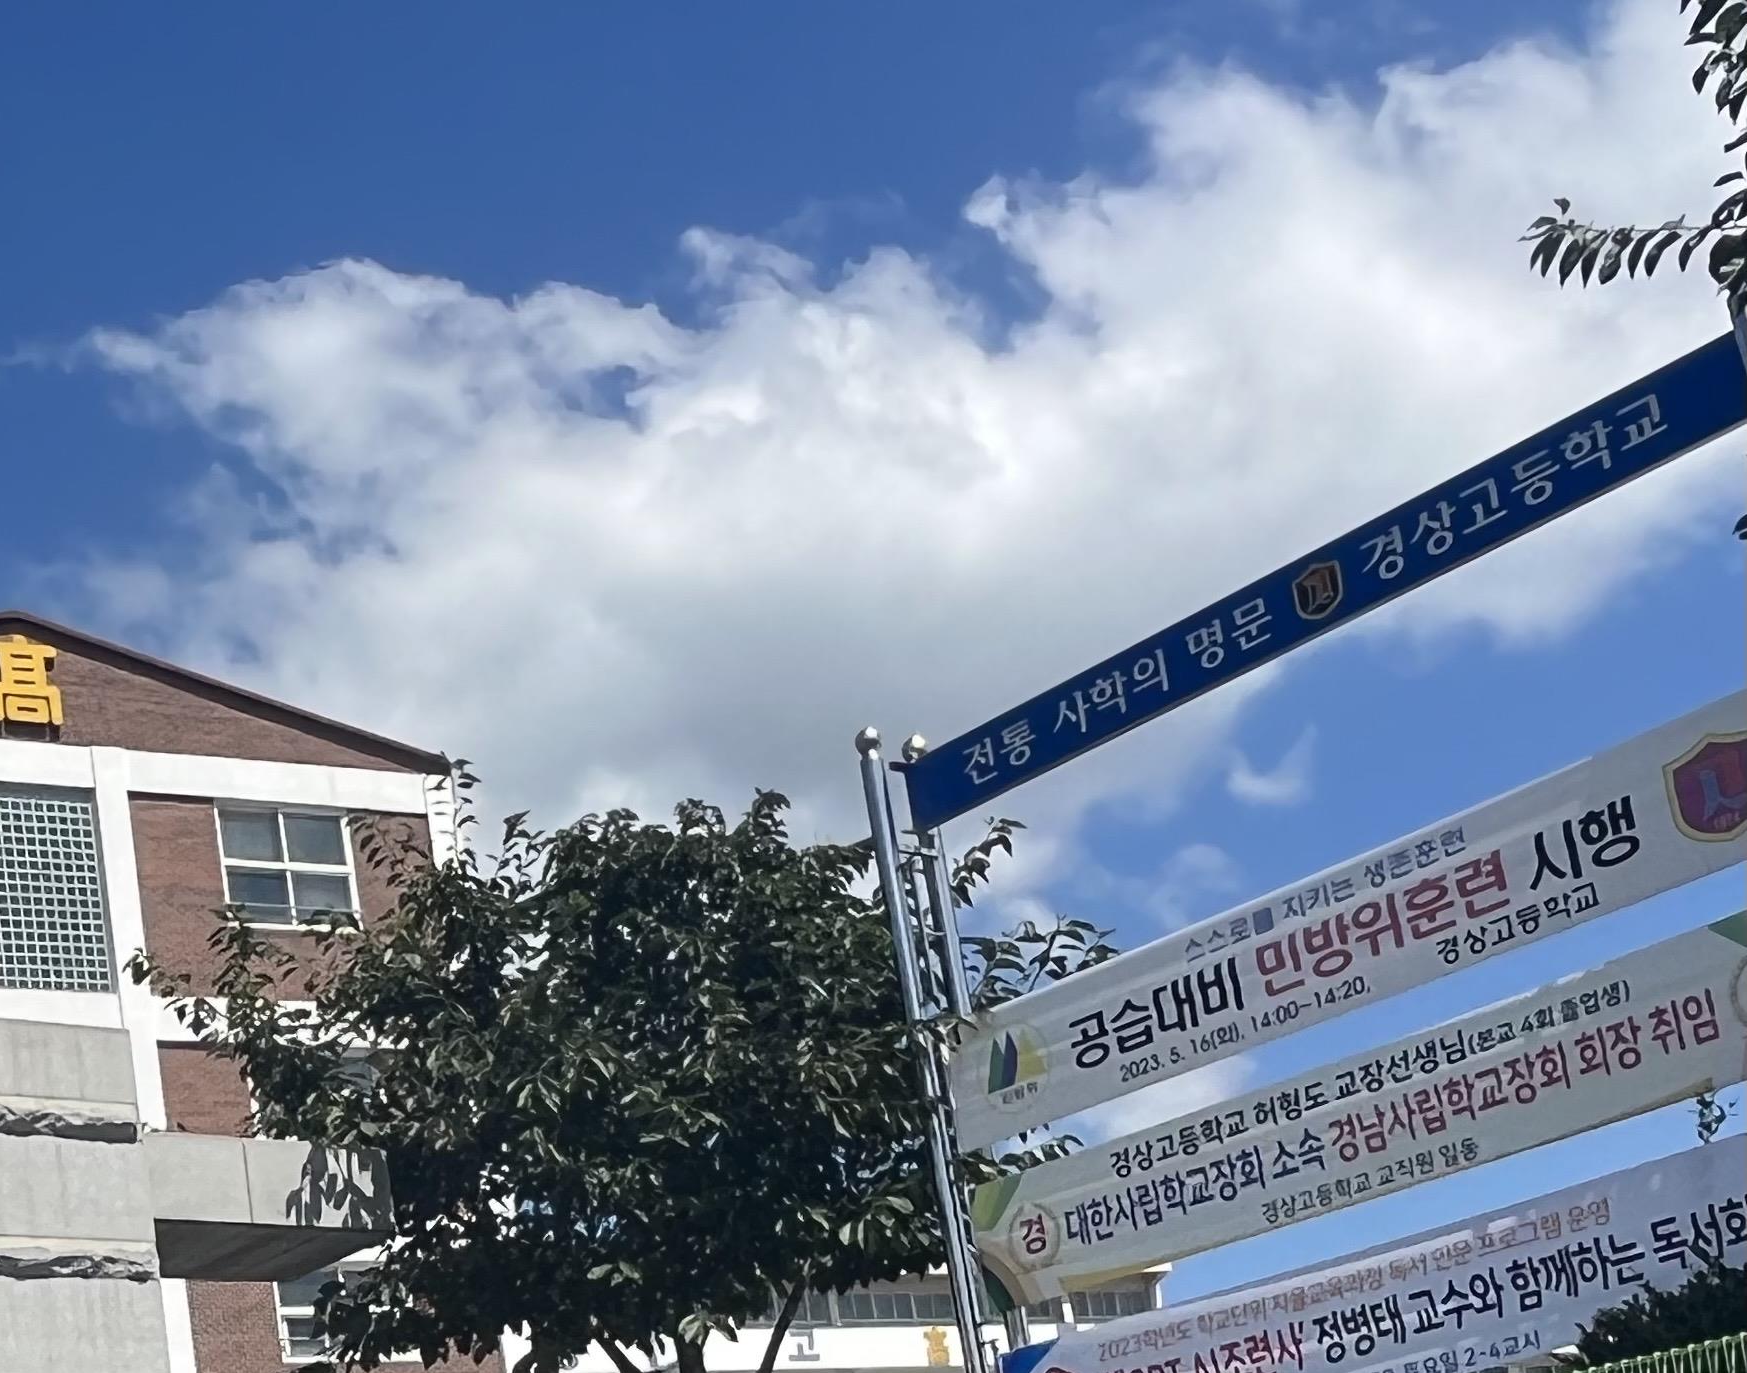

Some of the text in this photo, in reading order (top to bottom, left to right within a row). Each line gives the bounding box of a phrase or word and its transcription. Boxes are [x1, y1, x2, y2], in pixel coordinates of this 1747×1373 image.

[963, 394, 1668, 785] 전통 사학의 명문 경상고등학교
[1069, 795, 1640, 1069] 공습대비 민방위훈련 시행
[1282, 877, 1355, 919] 지키는
[1436, 882, 1600, 965] 경상고등학교
[1064, 987, 1720, 1245] 대한사립학교장회 소속 경남사립학교장회 회장 취임
[1110, 1110, 1250, 1178] 경상고등학교
[1262, 1137, 1479, 1224] 경상고등학교 교직원 일동
[1019, 1213, 1047, 1255] 경
[1475, 1212, 1561, 1257] 프로그램
[1568, 1197, 1610, 1232] 운영
[1313, 1294, 1406, 1364] 정병태
[1408, 1267, 1503, 1334] 교수와
[1506, 1234, 1645, 1312] 함께하는
